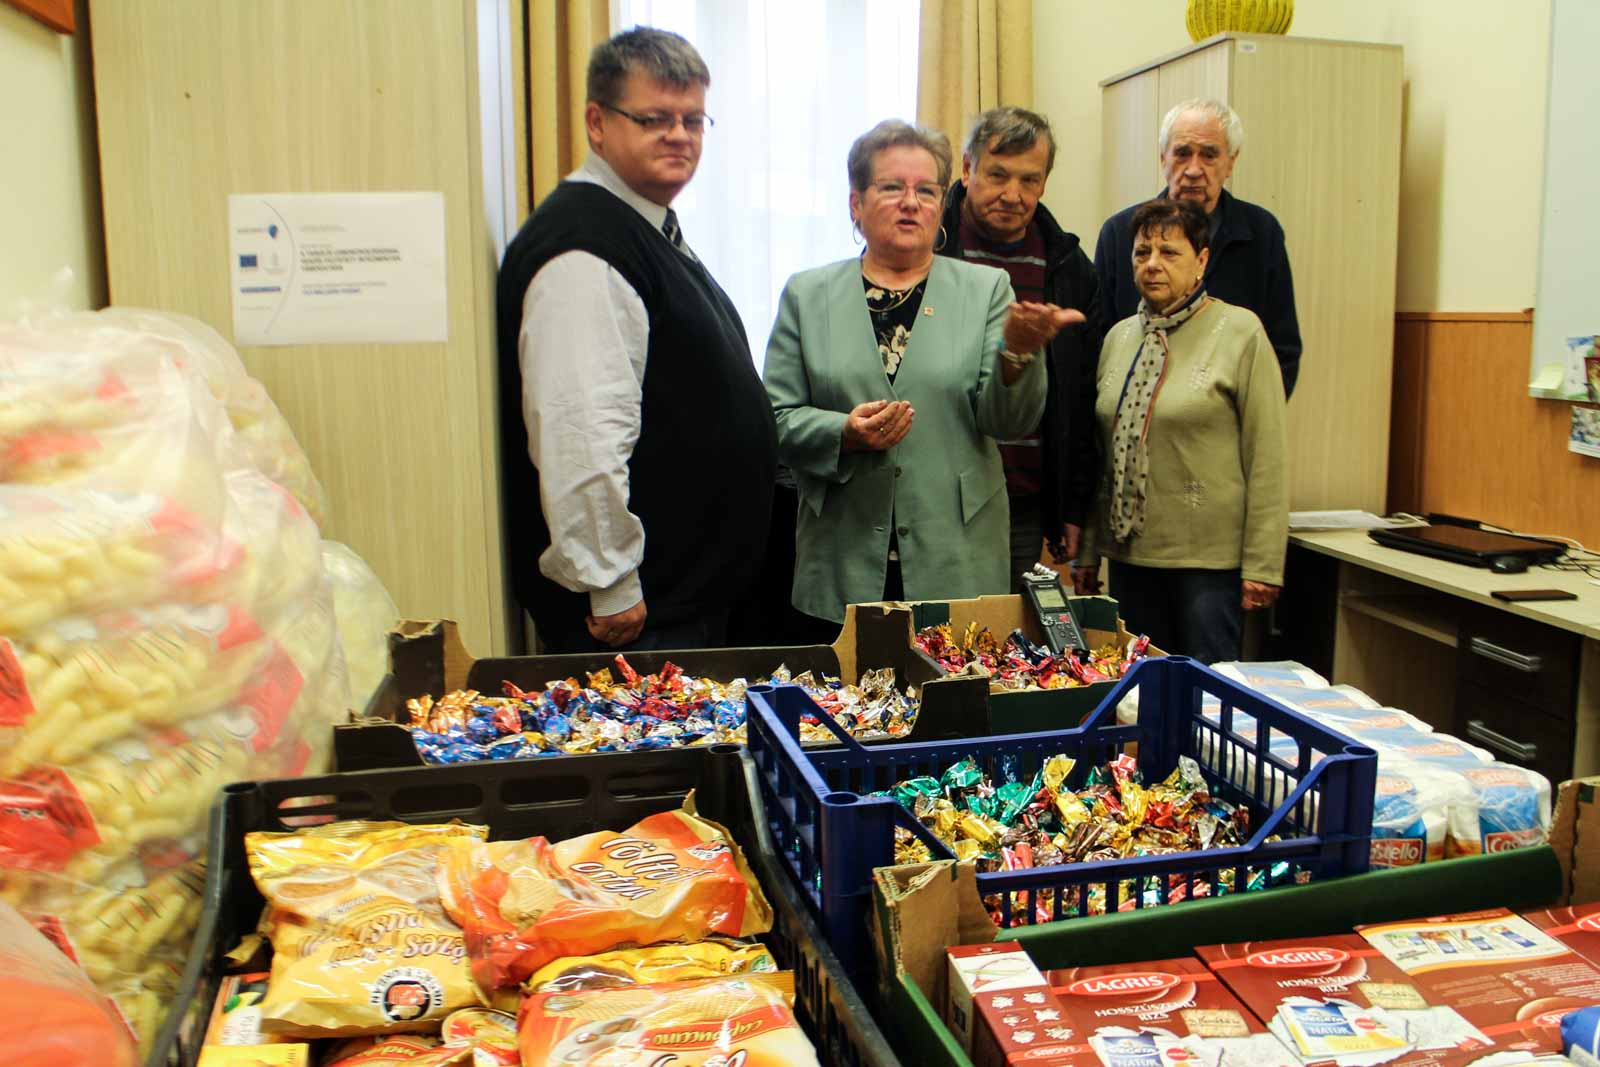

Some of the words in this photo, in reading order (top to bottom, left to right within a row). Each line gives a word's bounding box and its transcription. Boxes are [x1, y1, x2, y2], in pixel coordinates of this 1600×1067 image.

[1370, 842, 1419, 861] astello
[402, 933, 466, 965] ézes
[1258, 950, 1335, 965] LAGRIS
[1082, 975, 1165, 993] LAGRIS
[1319, 984, 1349, 994] RIZS
[1137, 1011, 1170, 1022] RIZS
